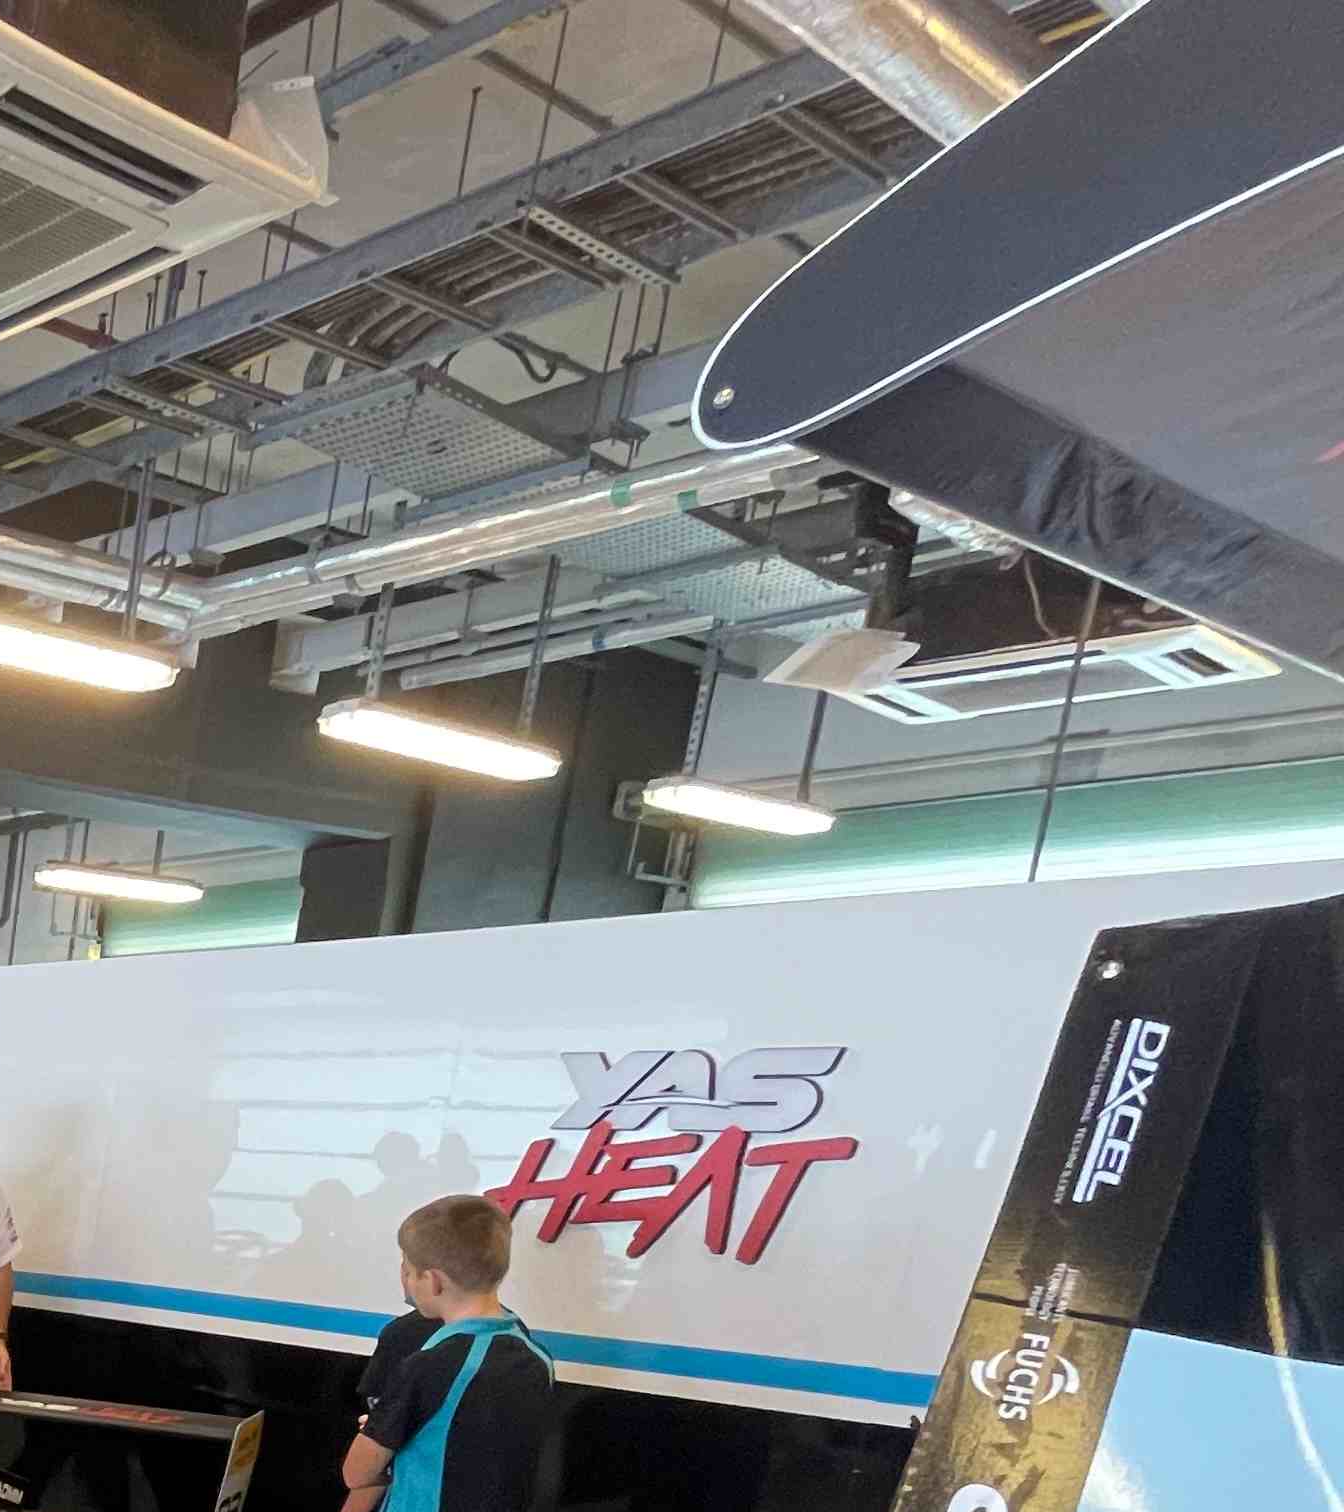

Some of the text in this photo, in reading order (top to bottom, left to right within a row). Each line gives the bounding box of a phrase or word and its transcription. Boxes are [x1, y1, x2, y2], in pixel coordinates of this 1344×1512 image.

[551, 1046, 848, 1132] YAS
[1080, 1020, 1171, 1202] DIXCEL
[484, 1121, 858, 1265] HEAT
[997, 1332, 1051, 1422] FUCHS
